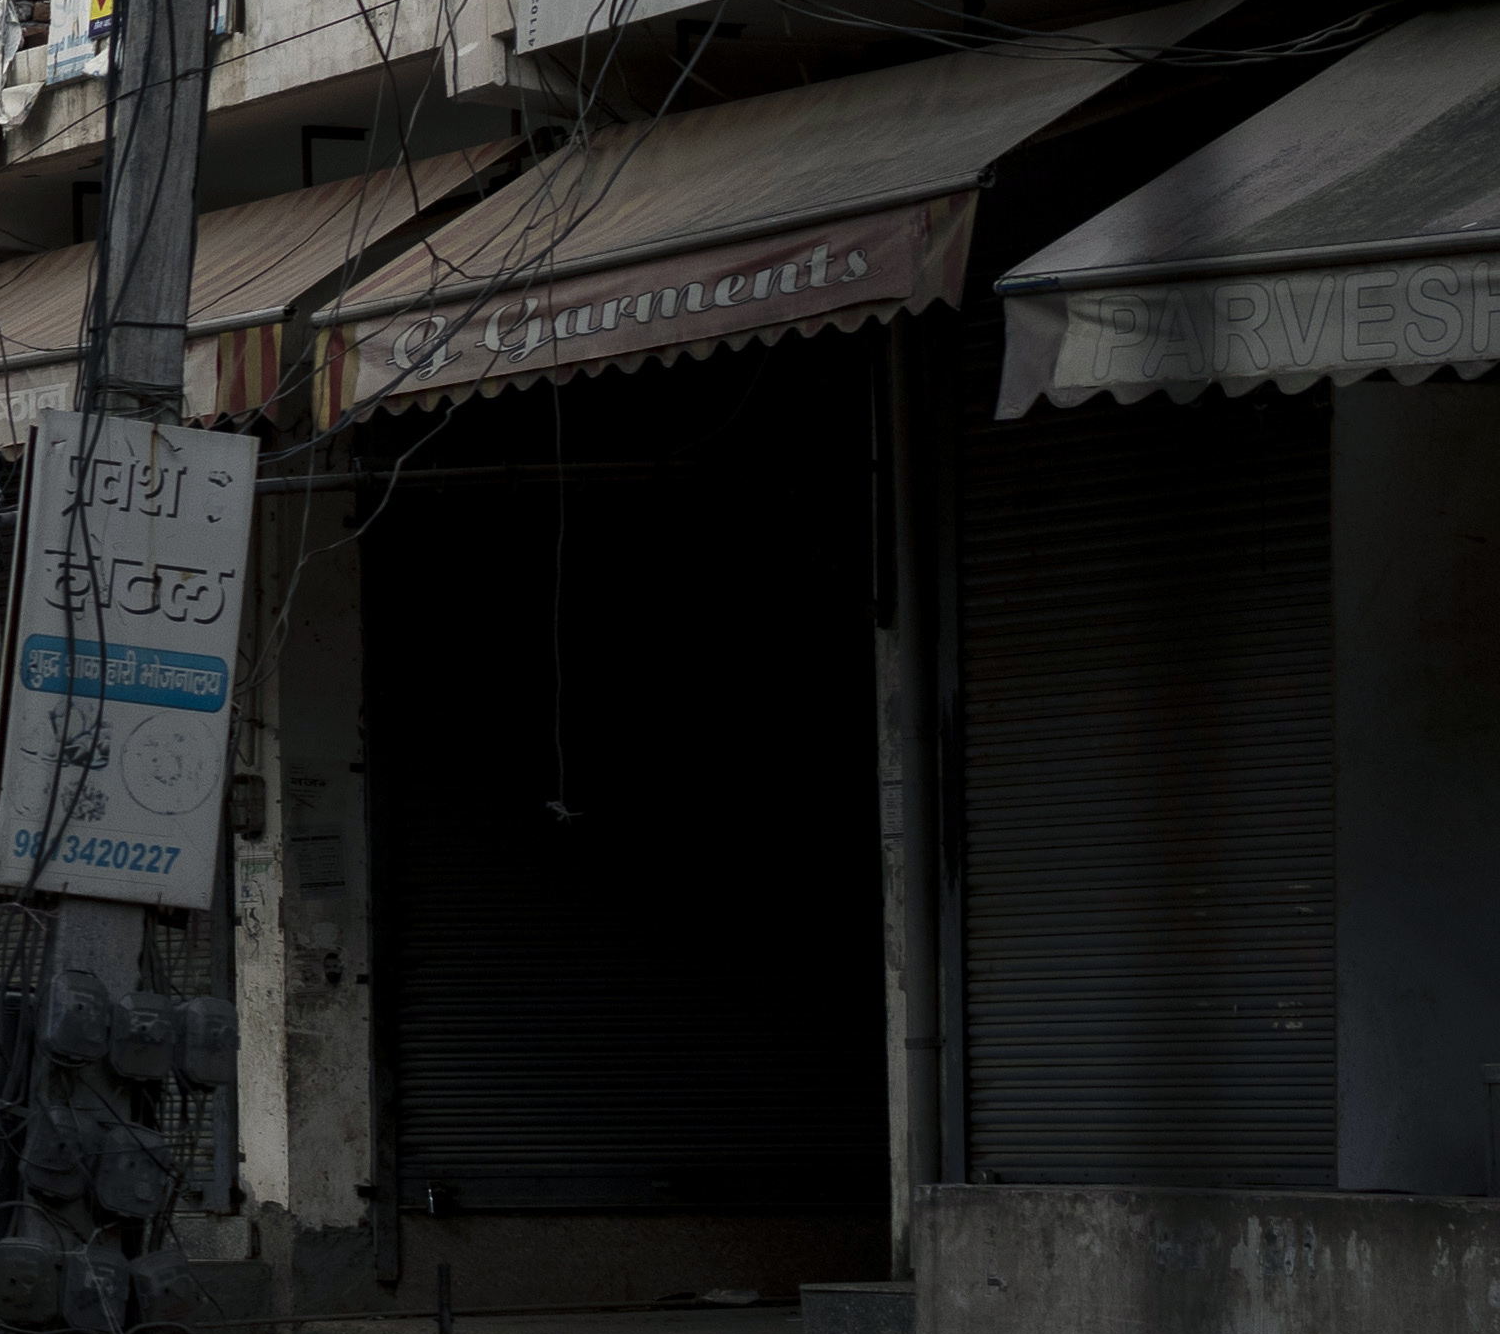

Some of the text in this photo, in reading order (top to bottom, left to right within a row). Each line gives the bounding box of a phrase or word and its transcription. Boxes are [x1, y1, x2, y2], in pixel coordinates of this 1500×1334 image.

[475, 241, 884, 362] Garments
[28, 648, 62, 689] शुद्ध
[139, 654, 223, 696] भोजनालय
